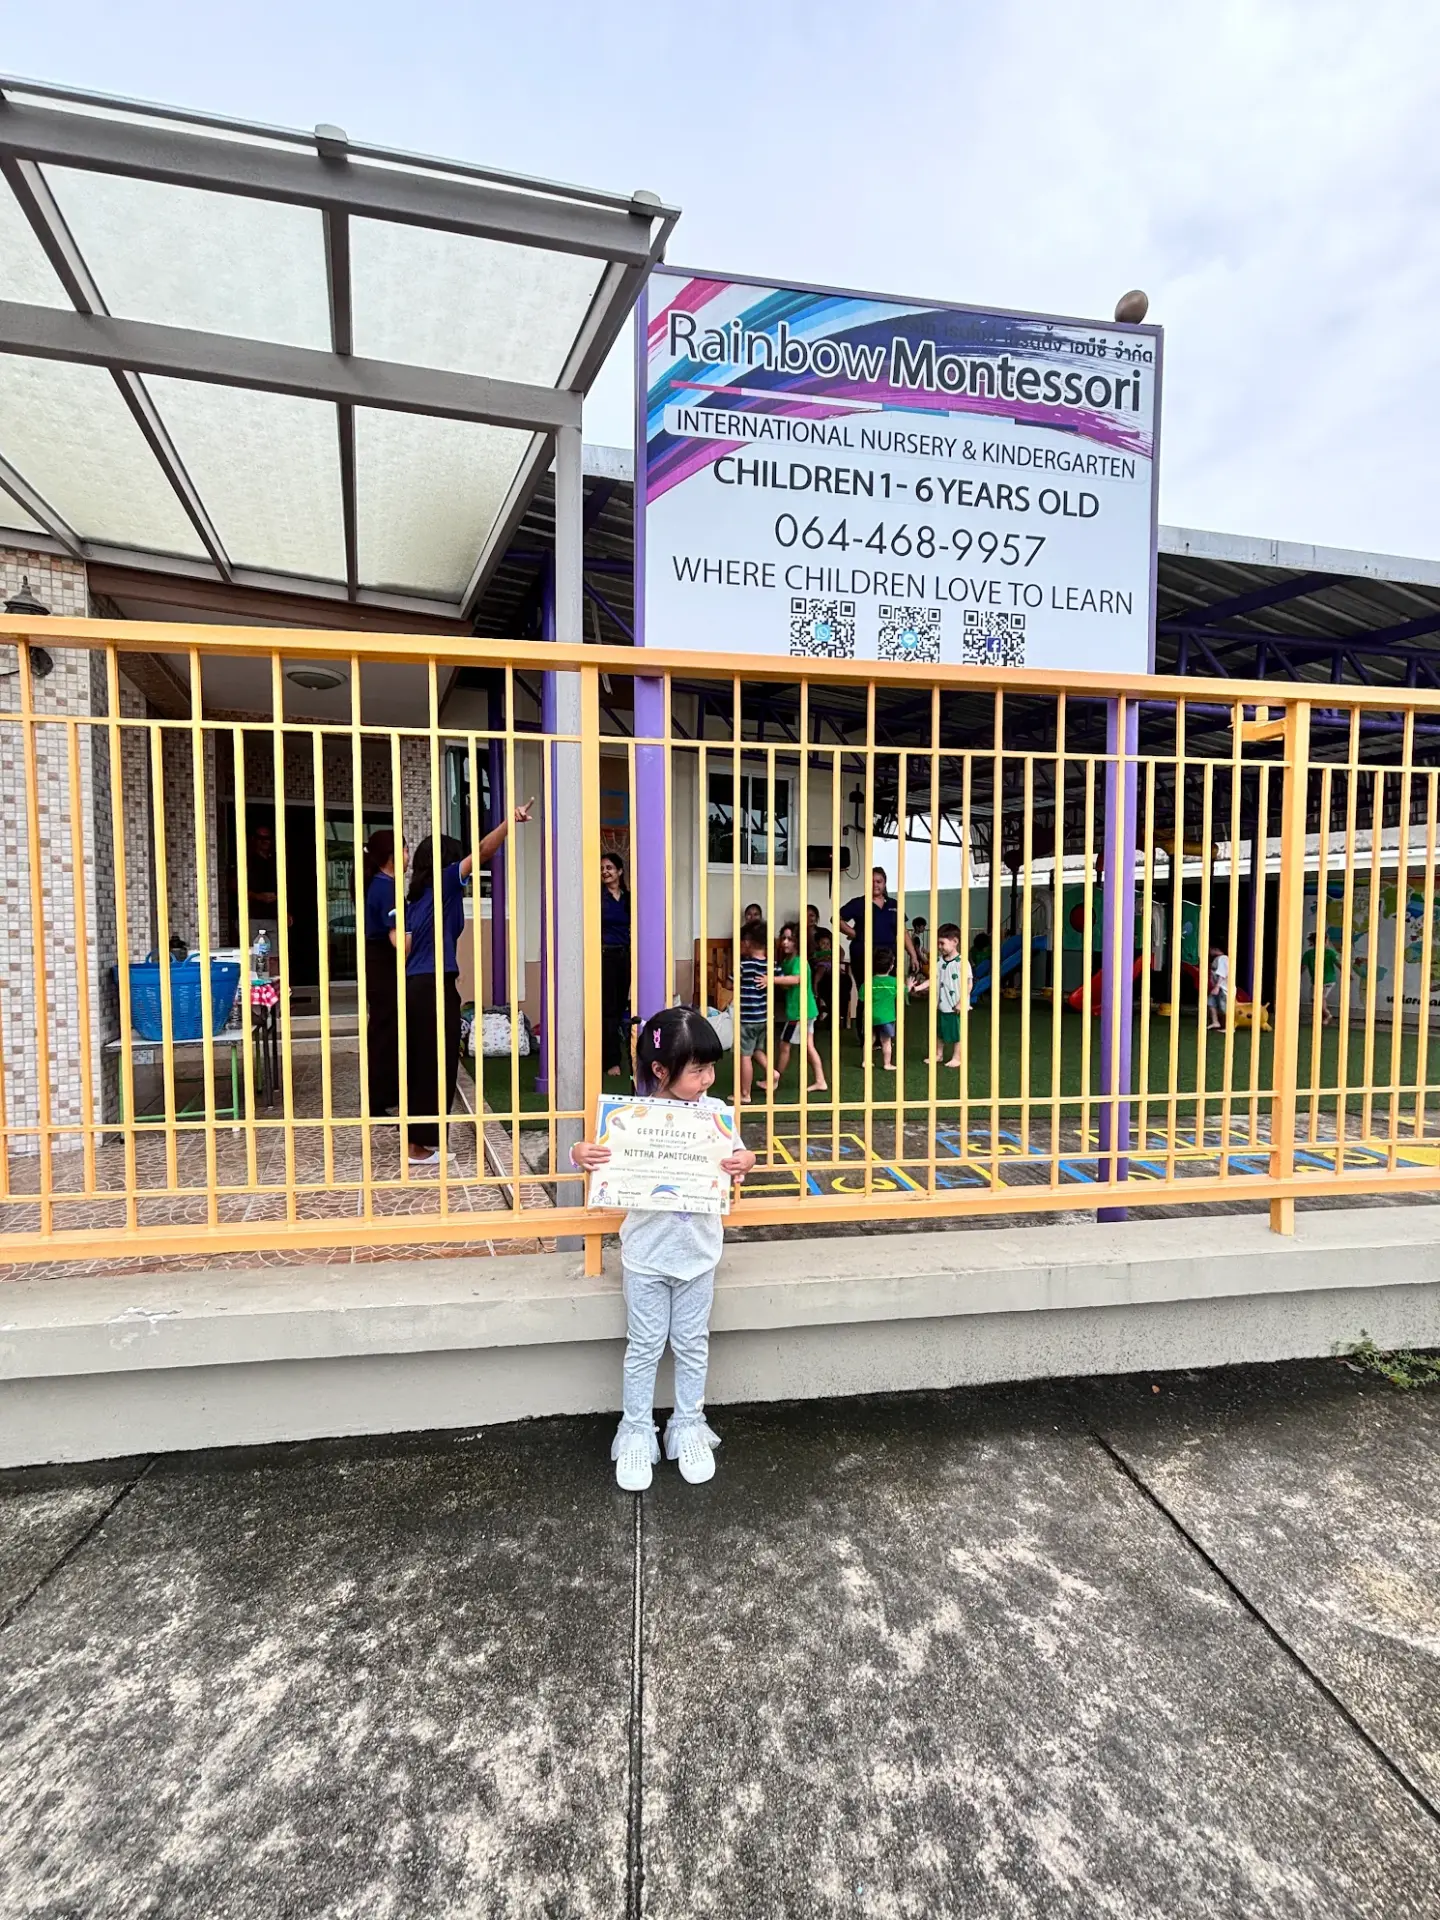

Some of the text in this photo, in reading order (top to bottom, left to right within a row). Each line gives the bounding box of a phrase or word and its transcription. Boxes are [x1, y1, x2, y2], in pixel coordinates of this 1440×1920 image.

[670, 312, 1141, 412] Rainbow Montessori
[1114, 339, 1154, 364] จำกัด
[677, 409, 1136, 479] INTERNATIONAL NURSERY & KINDERGARTEN
[713, 456, 874, 497] CHILDREN
[1038, 488, 1100, 518] OLD
[774, 513, 1046, 567] 064-468-9957
[672, 555, 1132, 615] WHERE CHILDREN LOVE TO LEARN
[624, 1148, 655, 1158] NITTHA
[637, 1127, 697, 1139] CERTIFICATE
